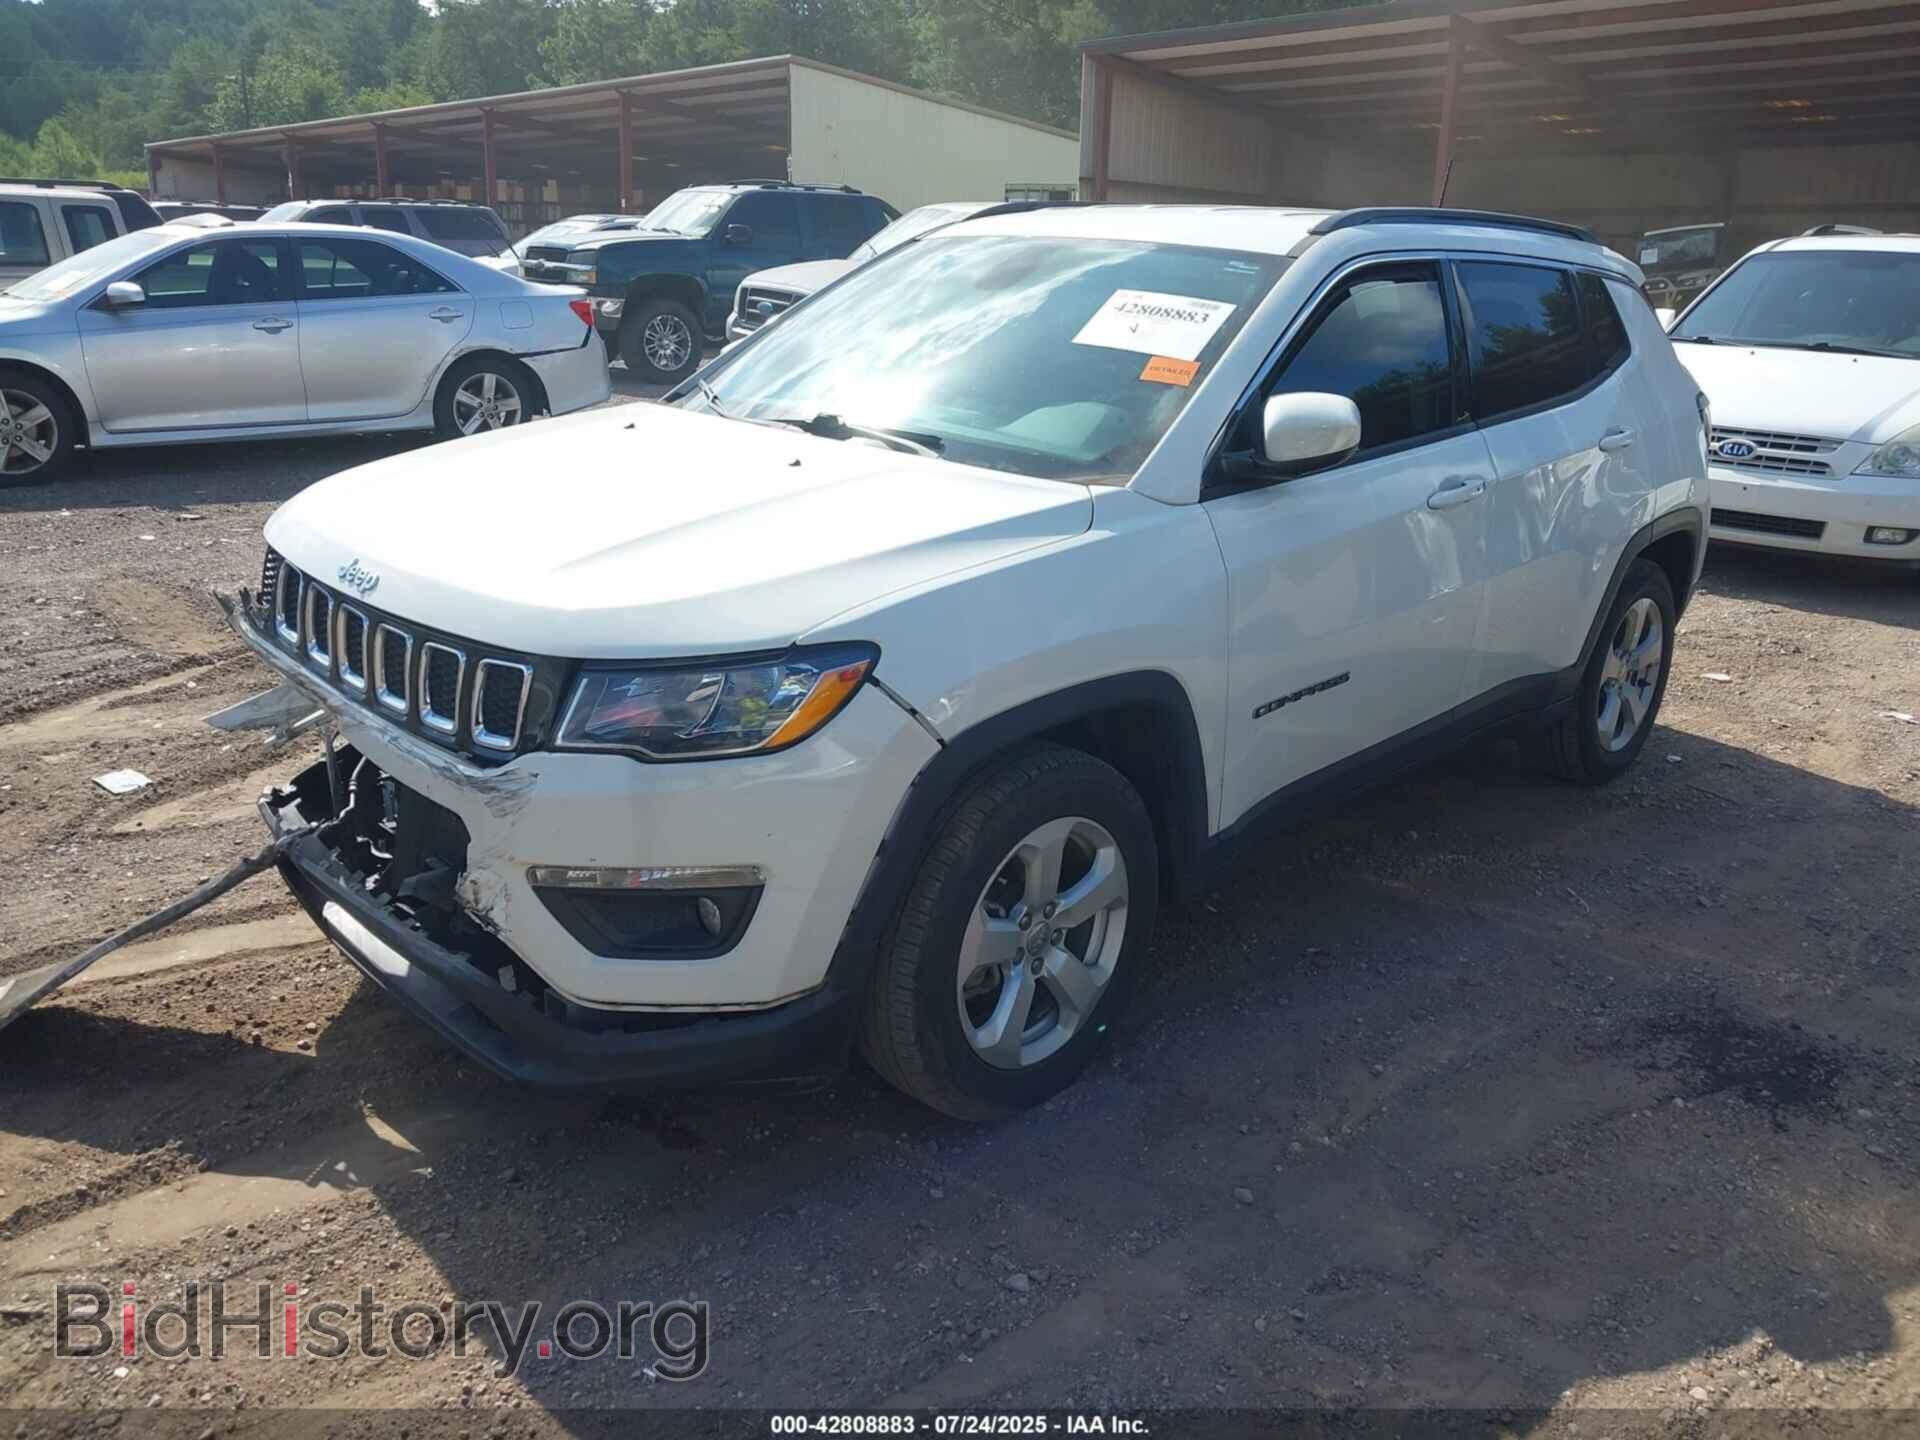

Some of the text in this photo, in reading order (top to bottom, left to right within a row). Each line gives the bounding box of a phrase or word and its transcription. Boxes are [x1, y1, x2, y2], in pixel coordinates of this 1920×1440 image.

[1113, 301, 1210, 325] 42808883
[1723, 443, 1749, 457] KIA
[336, 557, 381, 594] Jeep
